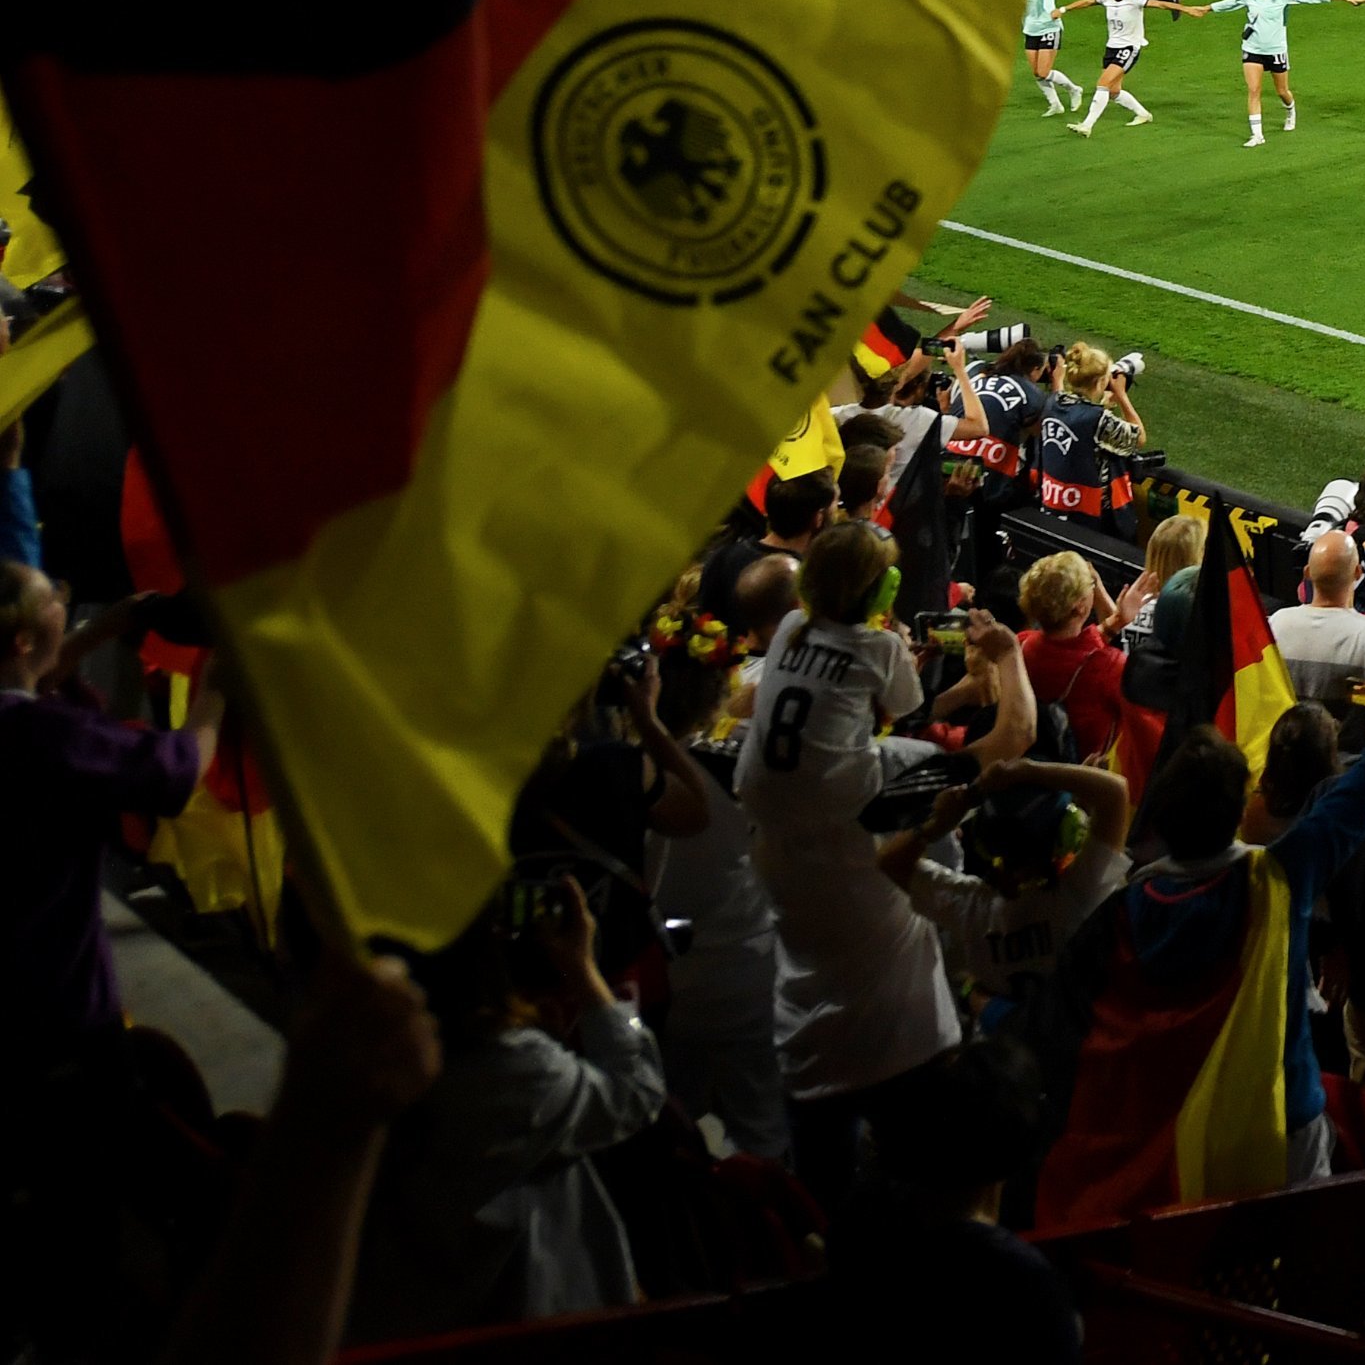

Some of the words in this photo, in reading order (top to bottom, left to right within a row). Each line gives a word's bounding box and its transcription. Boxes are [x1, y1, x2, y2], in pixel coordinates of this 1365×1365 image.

[770, 288, 845, 384] FAN
[830, 179, 923, 289] CLUB
[762, 687, 813, 772] 8
